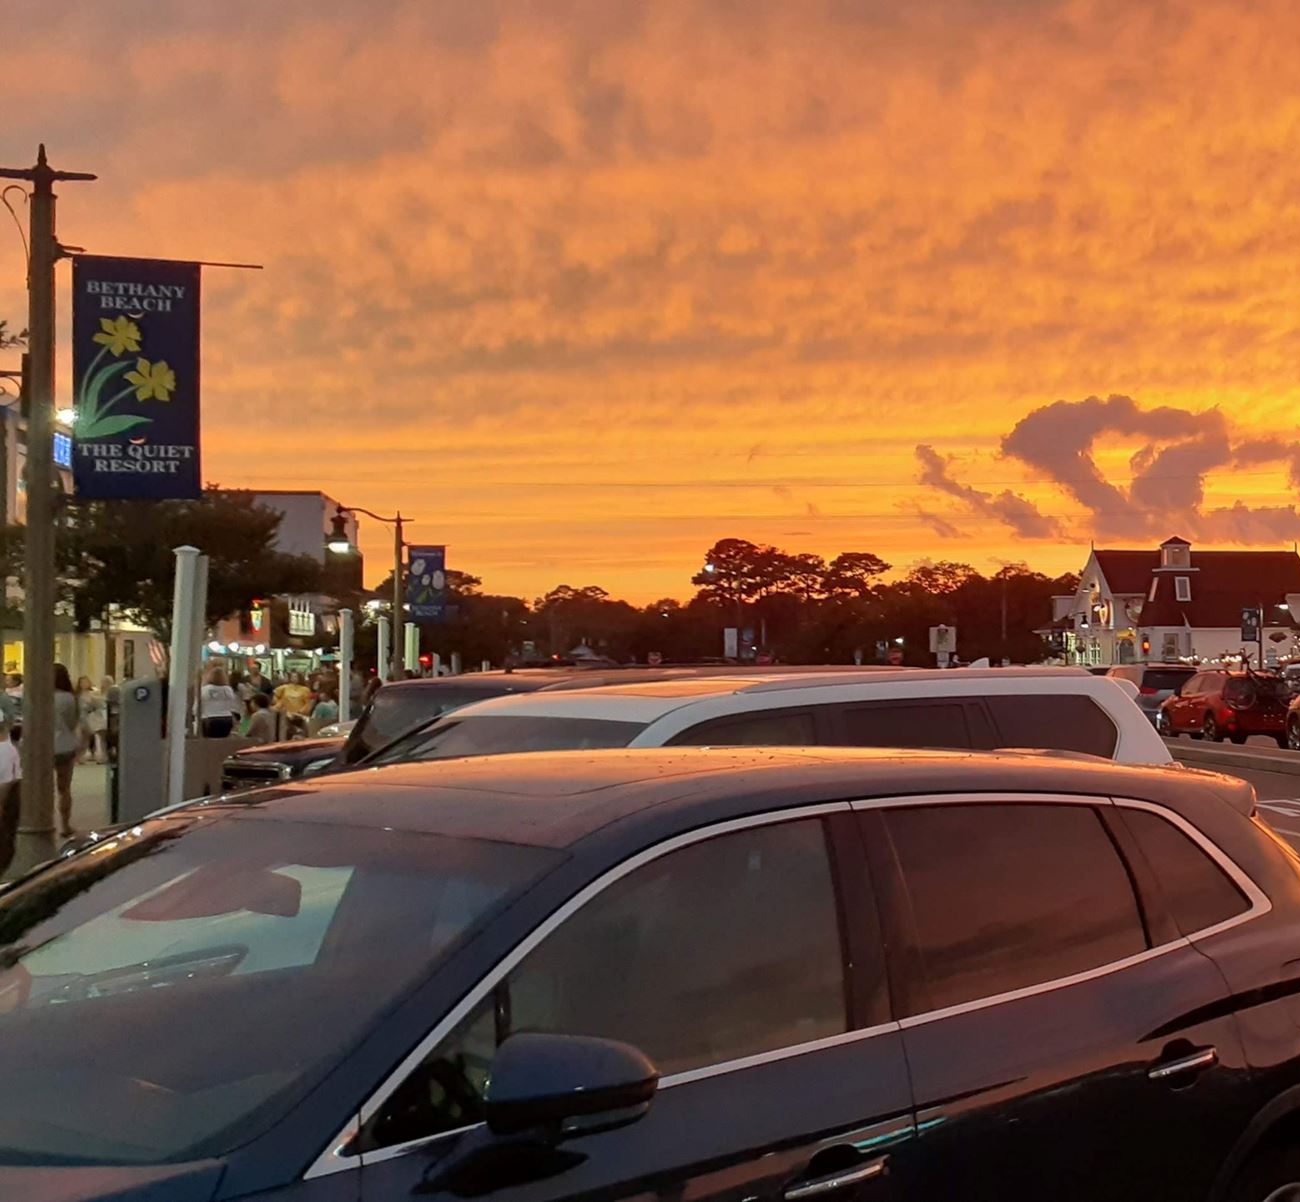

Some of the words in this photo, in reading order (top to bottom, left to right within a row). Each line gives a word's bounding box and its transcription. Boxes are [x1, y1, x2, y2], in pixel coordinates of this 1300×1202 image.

[86, 280, 185, 299] BETHANY
[100, 296, 172, 312] BEACH
[78, 443, 122, 457] THE
[128, 444, 194, 461] QUIET
[94, 459, 180, 473] RESORT
[136, 688, 147, 700] P
